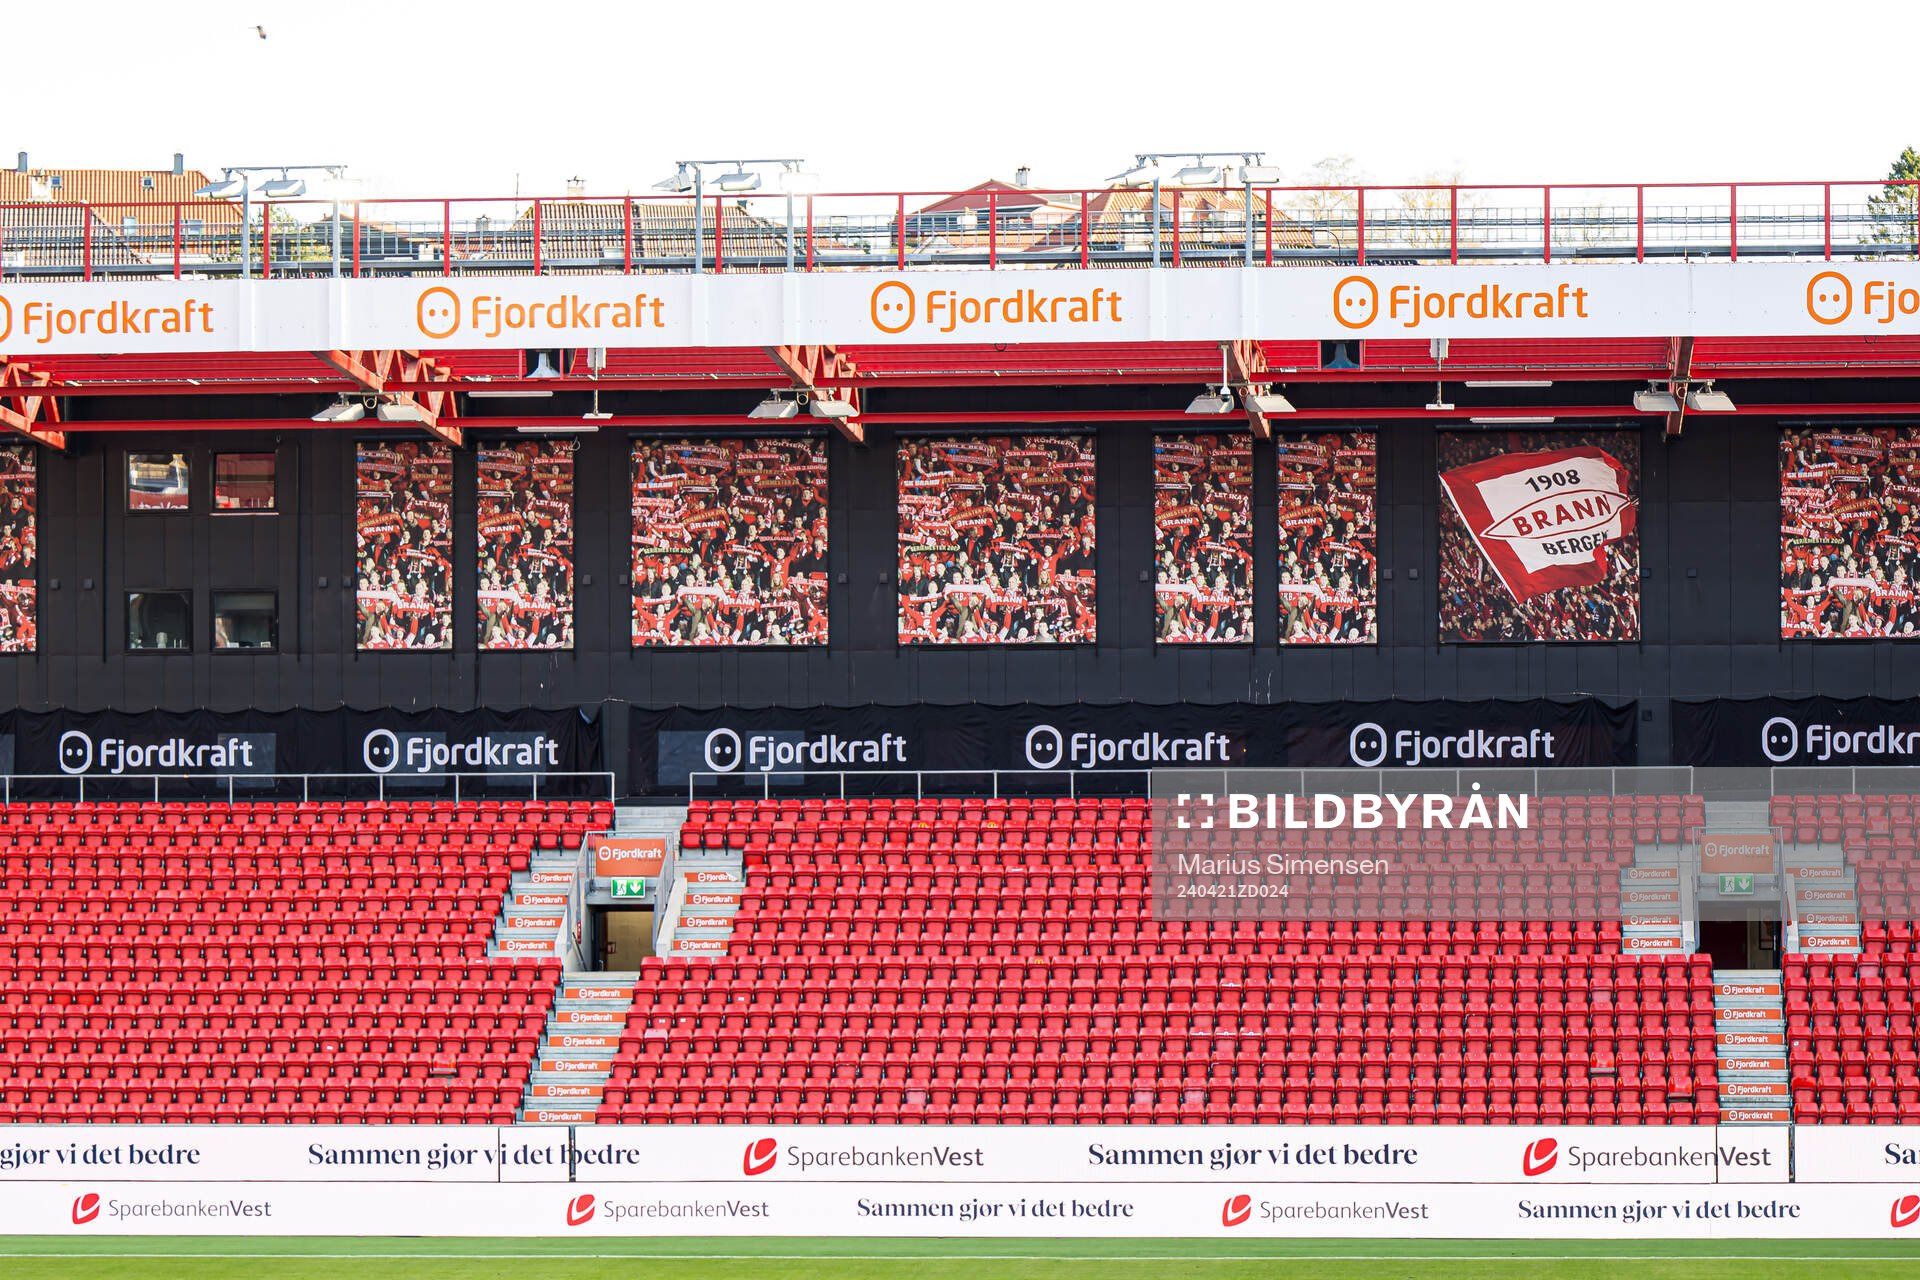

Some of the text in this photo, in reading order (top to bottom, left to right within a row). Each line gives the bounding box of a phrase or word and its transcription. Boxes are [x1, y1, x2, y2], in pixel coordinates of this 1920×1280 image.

[471, 293, 665, 339] Fjordkraft
[926, 287, 1122, 333] Fjordkraft
[1389, 282, 1589, 329] Fjordkraft
[23, 298, 214, 344] Fjordkraft
[1524, 469, 1581, 493] 1908
[690, 521, 720, 530] BRANN
[957, 518, 987, 527] BRANN
[1162, 517, 1193, 526] BRANN
[1286, 517, 1317, 526] BRANN
[1512, 494, 1612, 536] BRANN
[1841, 511, 1872, 520] BRANN
[364, 525, 394, 534] BRANN
[485, 525, 515, 534] BRANN
[724, 597, 755, 606] BRANN
[991, 595, 1022, 604] BRANN
[1197, 594, 1230, 603] BRANN
[1320, 594, 1353, 603] BRANN
[1876, 589, 1909, 598] BRANN
[398, 601, 430, 610] BRANN
[519, 601, 551, 610] BRANN
[100, 737, 253, 774] Fjordkraft
[406, 735, 559, 773] Fjordkraft
[749, 732, 907, 770] Fjordkraft
[1069, 731, 1230, 769] Fjordkraft
[1394, 729, 1555, 766] Fjordkraft
[612, 847, 662, 860] Fjordkraft
[1719, 844, 1770, 857] Fjordkraft
[0, 1143, 201, 1170] gjør vi det bedre
[308, 1142, 640, 1170] Sammen gjør vi det bedre
[788, 1145, 985, 1172] SparebankenVest
[1088, 1142, 1418, 1171] Sammen gjør vi det bedre
[1568, 1145, 1772, 1172] SparebankenVest
[1884, 1143, 1920, 1165] Sa
[108, 1198, 272, 1221] SparebankenVest
[604, 1199, 770, 1222] SparebankenVest
[857, 1198, 1134, 1221] Sammen gjør vi det bedre
[1260, 1200, 1429, 1224] SparebankenVest
[1518, 1199, 1801, 1223] Sammen gjør vi det bedre
